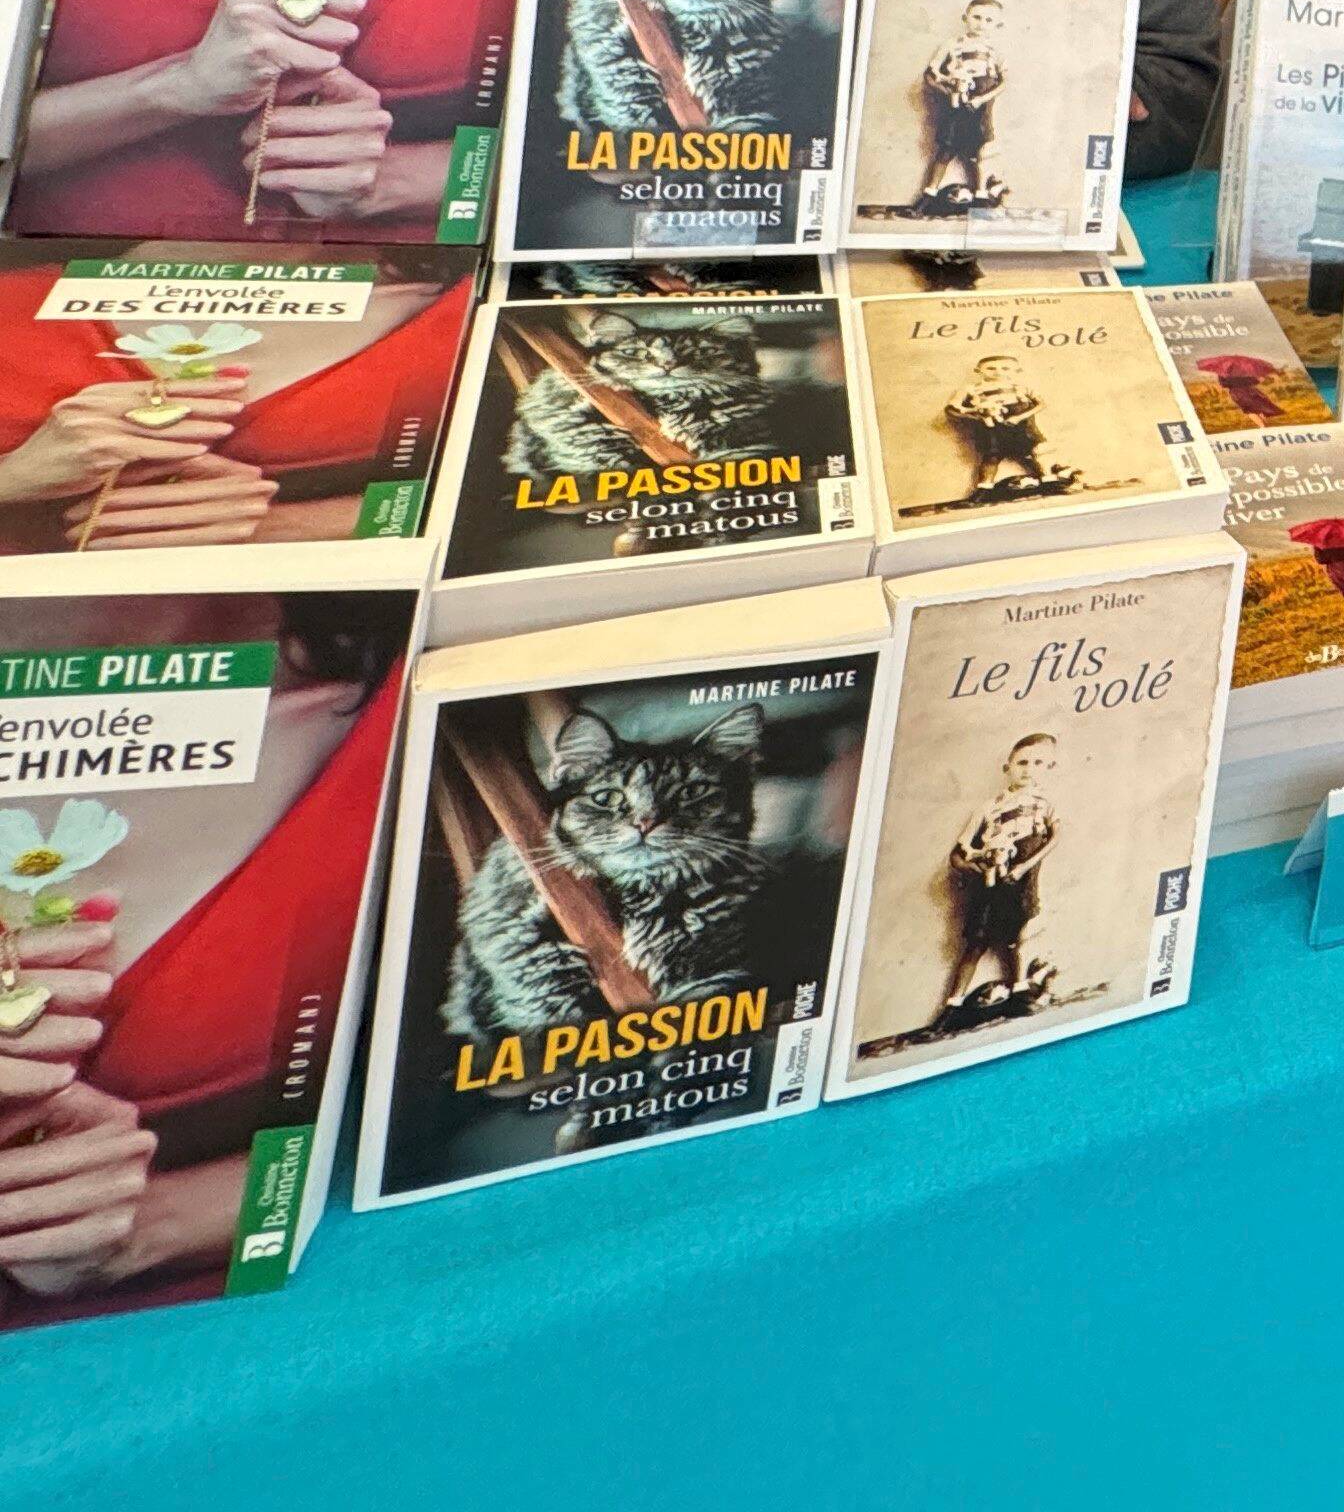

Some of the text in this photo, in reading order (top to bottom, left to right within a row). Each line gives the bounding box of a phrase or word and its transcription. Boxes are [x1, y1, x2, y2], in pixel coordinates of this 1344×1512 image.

[1276, 63, 1313, 86] Les
[1274, 96, 1297, 110] de
[1300, 96, 1316, 113] la
[567, 131, 792, 171] LA PASSION
[620, 177, 704, 200] selon
[715, 178, 783, 206] cinq
[667, 208, 782, 227] matous
[100, 262, 347, 281] MARTINE PILATE
[147, 283, 285, 300] L'envolée
[940, 296, 1061, 310] Martine Pilate
[1173, 291, 1232, 300] Pilate
[62, 297, 348, 316] DES CHIMÈRES
[691, 303, 823, 315] MARTINE PILATE
[910, 315, 1041, 341] Le fils
[1158, 315, 1205, 330] ays
[1165, 323, 1249, 339] ossible
[1021, 327, 1108, 348] volé
[1262, 432, 1331, 446] Pilate
[515, 476, 580, 510] LA
[596, 455, 801, 501] PASSION
[585, 489, 797, 525] selon cinq
[1227, 506, 1285, 526] iver
[646, 509, 799, 540] matous
[1002, 590, 1146, 625] Martine Pilate
[1, 650, 236, 692] TINE PILATE
[948, 636, 1109, 701] Le fils
[689, 670, 857, 706] MARTINE PILATE
[1073, 659, 1174, 714] volé
[793, 980, 817, 1019] POCHE
[455, 987, 769, 1092] LA PASSION
[528, 1072, 647, 1113] selon
[661, 1045, 753, 1084] cinq
[590, 1077, 748, 1129] matous
[262, 1135, 304, 1228] Bonneton
